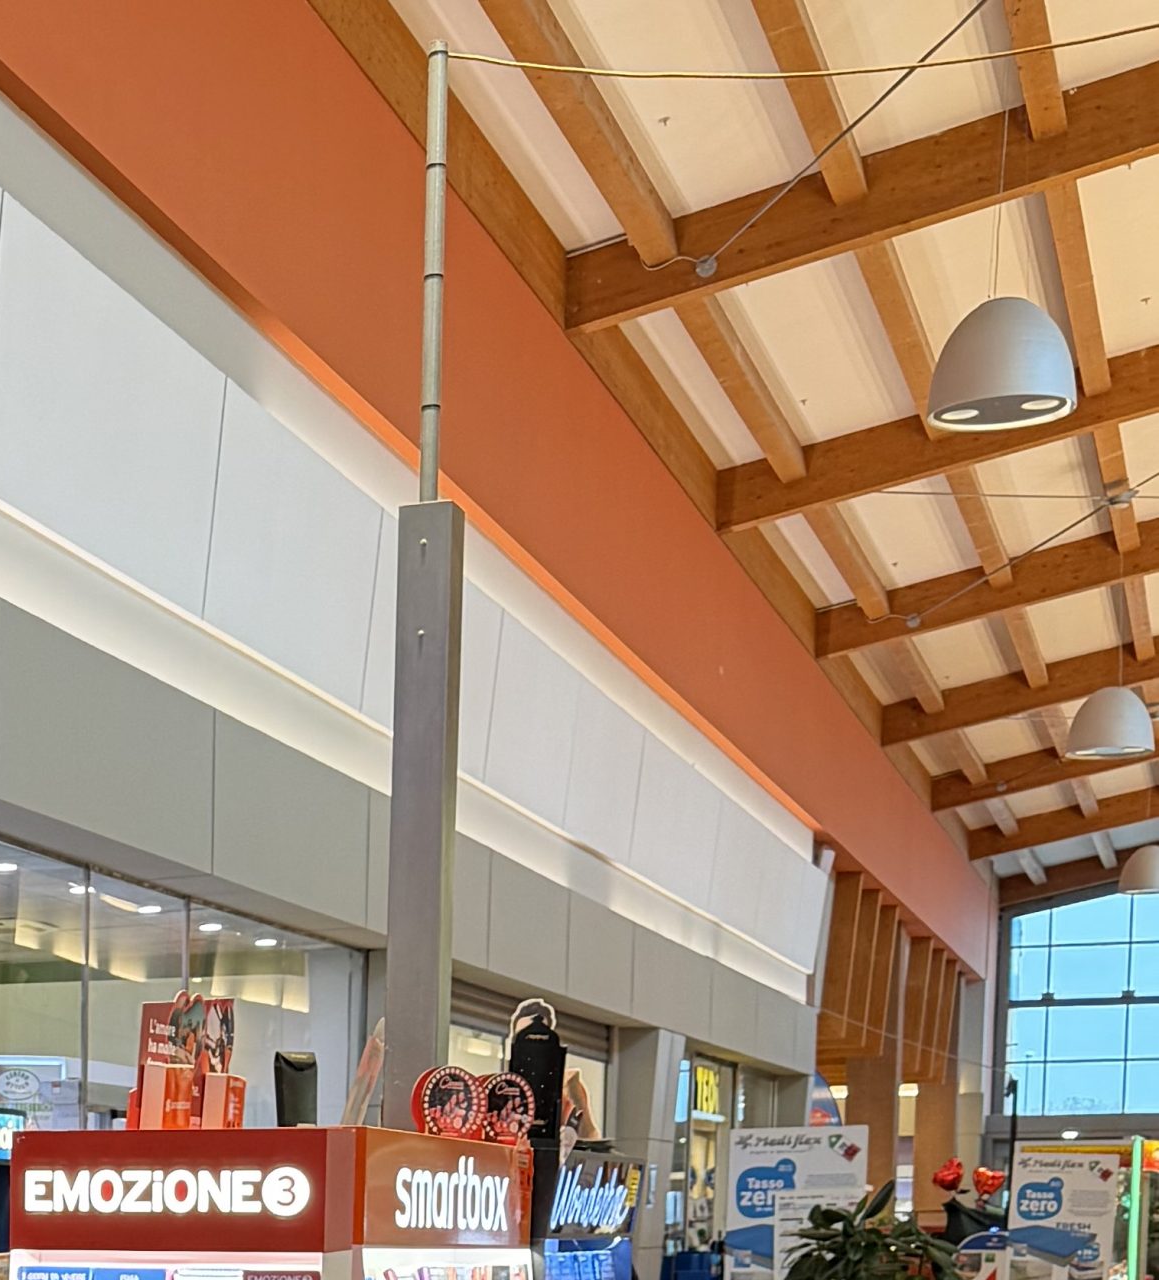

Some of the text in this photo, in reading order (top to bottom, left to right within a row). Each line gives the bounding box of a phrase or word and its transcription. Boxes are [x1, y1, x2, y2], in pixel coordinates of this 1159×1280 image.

[746, 1177, 784, 1188] Tasso
[395, 1156, 510, 1231] smartbox
[740, 1190, 776, 1206] zer
[1025, 1189, 1055, 1199] Tasso
[1019, 1199, 1058, 1212] zero
